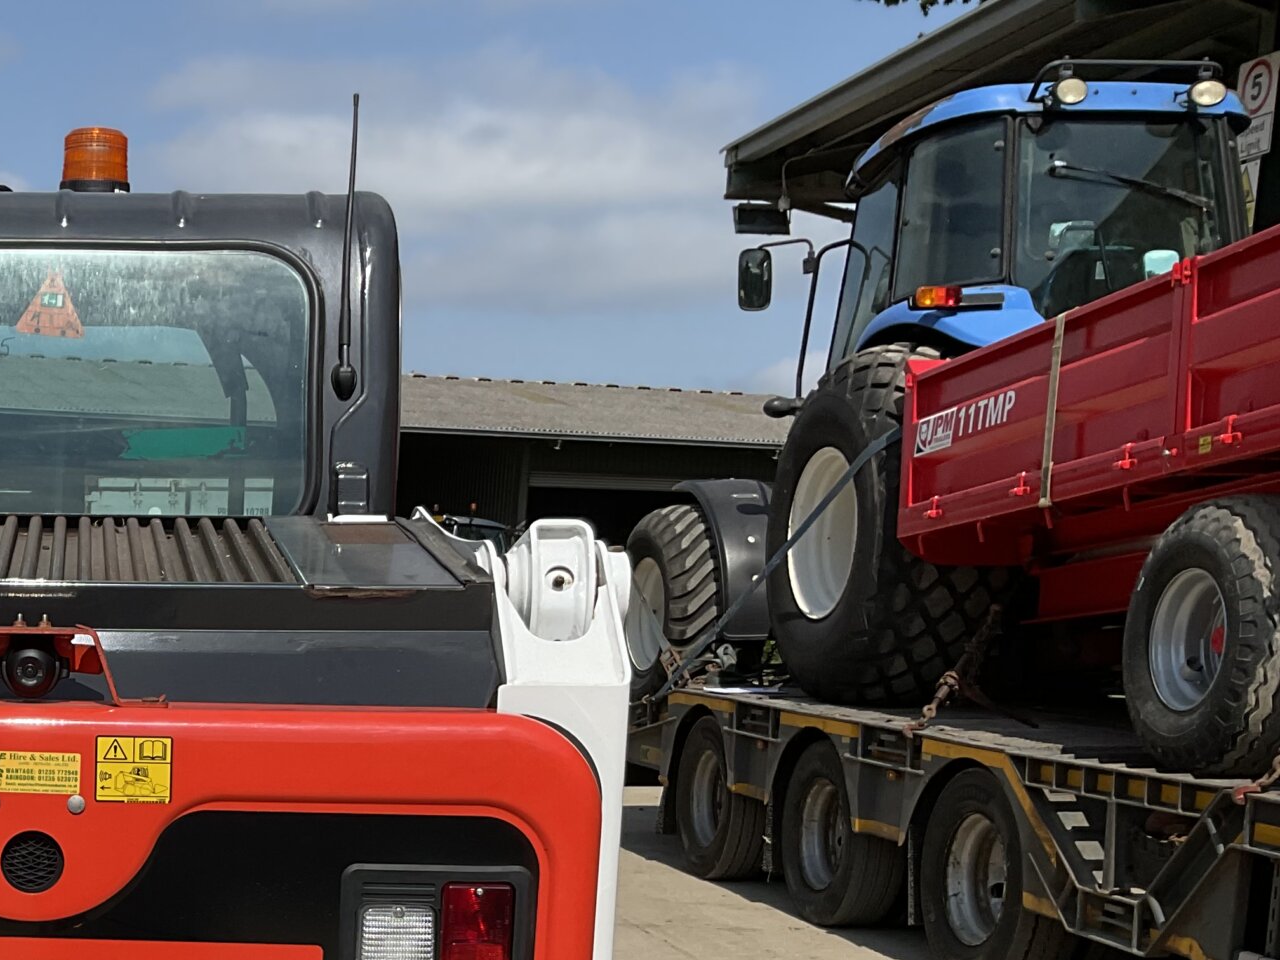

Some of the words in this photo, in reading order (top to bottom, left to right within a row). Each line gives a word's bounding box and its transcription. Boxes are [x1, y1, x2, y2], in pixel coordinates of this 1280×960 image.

[1250, 72, 1263, 100] 5
[959, 390, 1015, 437] 11TMP
[9, 752, 27, 761] Hire
[39, 754, 59, 762] Sales
[61, 755, 79, 763] Ltd.
